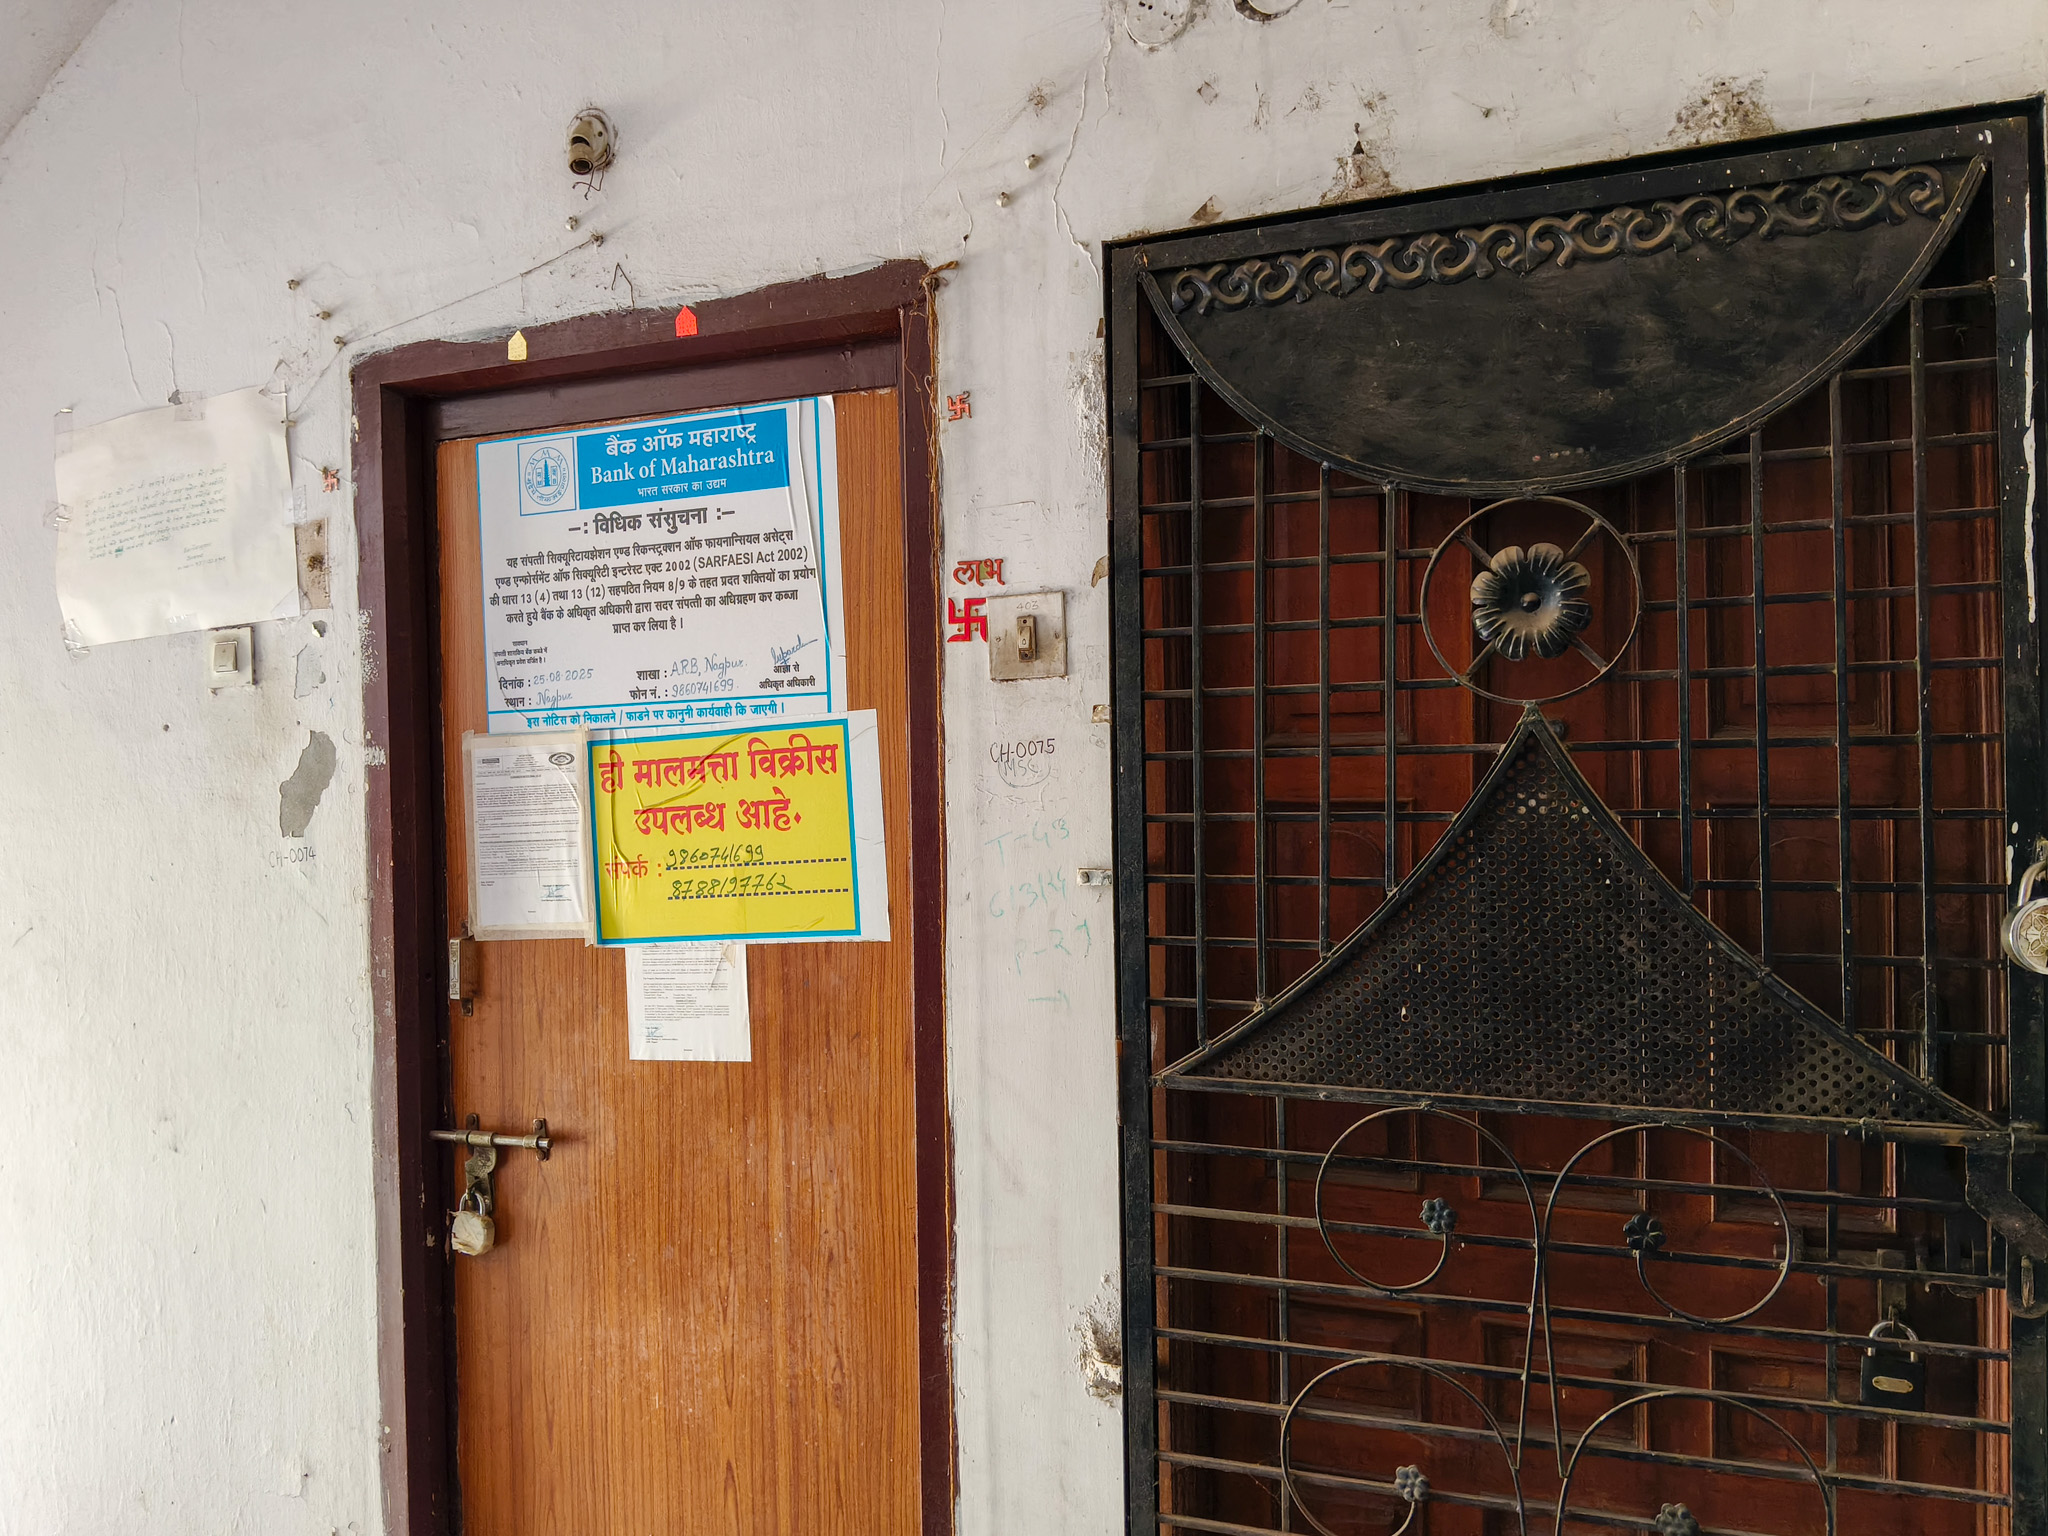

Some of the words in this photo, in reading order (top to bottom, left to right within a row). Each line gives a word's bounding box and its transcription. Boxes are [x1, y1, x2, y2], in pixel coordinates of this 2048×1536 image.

[605, 434, 637, 457] बैंक
[642, 428, 683, 452] ऑफ
[689, 422, 757, 447] महाराष्ट्र
[591, 461, 635, 484] Bank
[639, 458, 657, 478] of
[661, 448, 775, 475] Maharashtra
[637, 486, 658, 498] भारत
[661, 483, 688, 495] सरकार
[692, 481, 704, 491] का
[706, 478, 727, 489] उद्यम
[593, 510, 642, 534] विधिक
[646, 507, 708, 534] संसुचना
[506, 557, 518, 568] यह
[520, 551, 545, 566] संपत्ती
[613, 545, 631, 559] एण्ड
[685, 536, 702, 550] ऑफ
[705, 532, 760, 549] फायनान्सियल
[763, 528, 793, 544] असेट्स
[495, 576, 511, 589] एण्ड
[553, 568, 570, 583] ऑफ
[572, 563, 609, 583] सिक्यूरिटी
[611, 562, 643, 578] इन्टरेस्ट
[645, 561, 662, 575] एक्ट
[665, 559, 691, 573] 2002
[693, 553, 754, 572] (SARFAESI
[756, 551, 774, 564] Act
[777, 546, 808, 562] 2002)
[953, 558, 1006, 586] लाभ
[489, 594, 500, 606] की
[502, 595, 518, 605] धारा
[521, 593, 531, 603] 13
[534, 589, 550, 605] (4)
[552, 590, 569, 601] तथा
[571, 589, 582, 599] 13
[586, 584, 605, 600] (12)
[607, 580, 641, 596] सहपठित
[643, 578, 665, 593] नियम
[668, 577, 685, 594] 8/9
[688, 575, 697, 589] के
[699, 576, 718, 589] तहत
[742, 568, 776, 584] शक्तियों
[778, 569, 790, 581] का
[793, 564, 816, 580] प्रयोग
[506, 609, 523, 624] करते
[526, 608, 538, 627] हुये
[540, 607, 554, 621] बैंक
[556, 606, 565, 620] के
[567, 604, 596, 621] अधिकृत
[599, 599, 633, 615] अधिकारी
[635, 602, 652, 614] द्वारा
[655, 600, 673, 612] सदर
[676, 594, 702, 610] संपत्ती
[705, 595, 716, 607] का
[718, 591, 756, 606] अधिग्रहण
[759, 591, 773, 603] कर
[774, 589, 798, 602] कब्जा
[1016, 600, 1040, 611] 403
[612, 621, 631, 634] प्राप्त
[633, 620, 646, 632] कर
[648, 617, 668, 632] लिया
[669, 615, 677, 630] है
[636, 668, 660, 681] शाखा
[793, 661, 800, 672] से
[498, 676, 524, 690] दिनांक
[629, 686, 647, 701] फोन
[759, 679, 784, 691] अधिकृत
[786, 676, 816, 688] अधिकारी
[504, 697, 525, 708] स्थान
[526, 716, 540, 729] इस
[542, 713, 567, 726] नोटिस
[570, 711, 581, 725] को
[583, 708, 616, 724] निकालने
[625, 705, 650, 721] फाडने
[653, 708, 665, 720] पर
[667, 704, 694, 723] कानुनी
[696, 702, 732, 718] कार्यवाही
[735, 702, 747, 715] कि
[750, 700, 778, 715] जाएगी
[598, 750, 624, 794] ही
[632, 751, 739, 790] मालमत्ता
[748, 733, 838, 780] विक्रीस
[990, 738, 1055, 763] CH-0075
[633, 801, 725, 837] उपलब्ध
[268, 846, 316, 868] CH-0074
